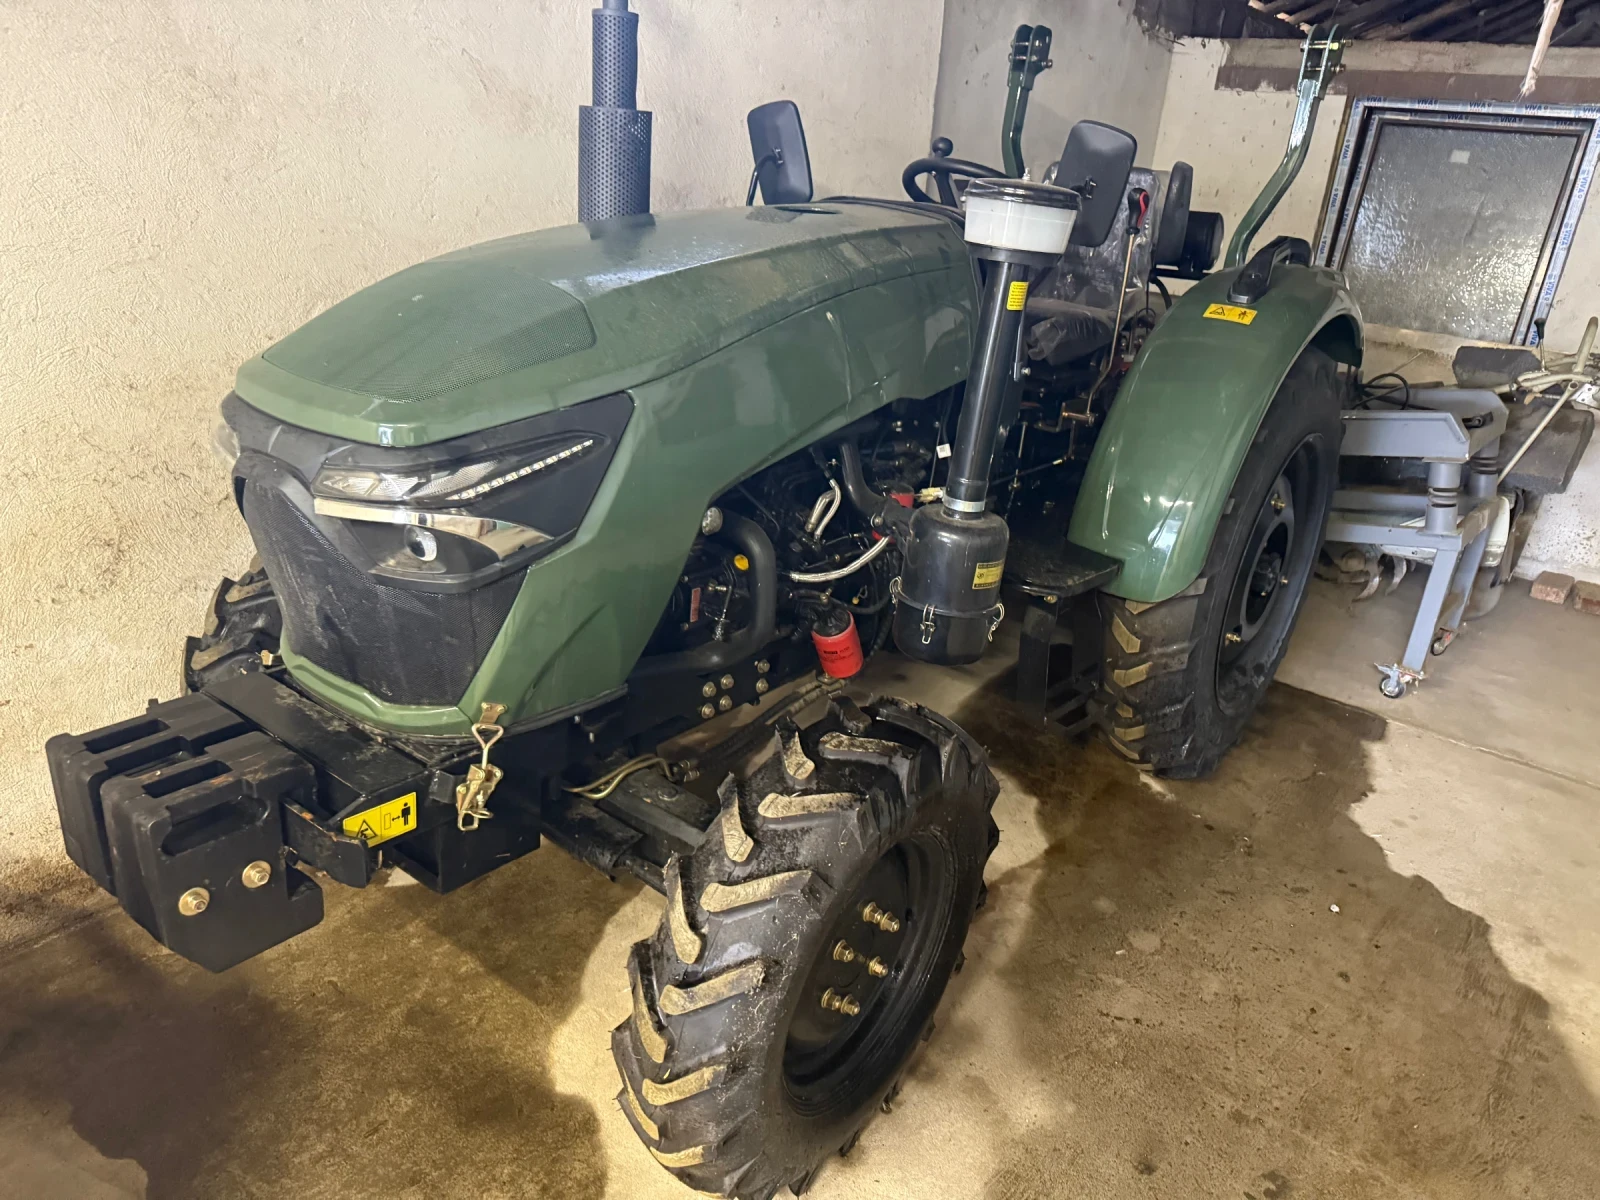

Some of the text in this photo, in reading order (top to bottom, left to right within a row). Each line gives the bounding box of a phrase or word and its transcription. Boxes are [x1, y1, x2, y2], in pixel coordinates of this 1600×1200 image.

[1447, 113, 1464, 121] VIVA
[1342, 144, 1351, 160] VIVA
[1578, 176, 1590, 193] VIVA
[1330, 193, 1339, 208] VIVA
[1561, 229, 1573, 246] VIVA
[1319, 240, 1327, 255] VIVA
[1544, 281, 1556, 296] VIVA
